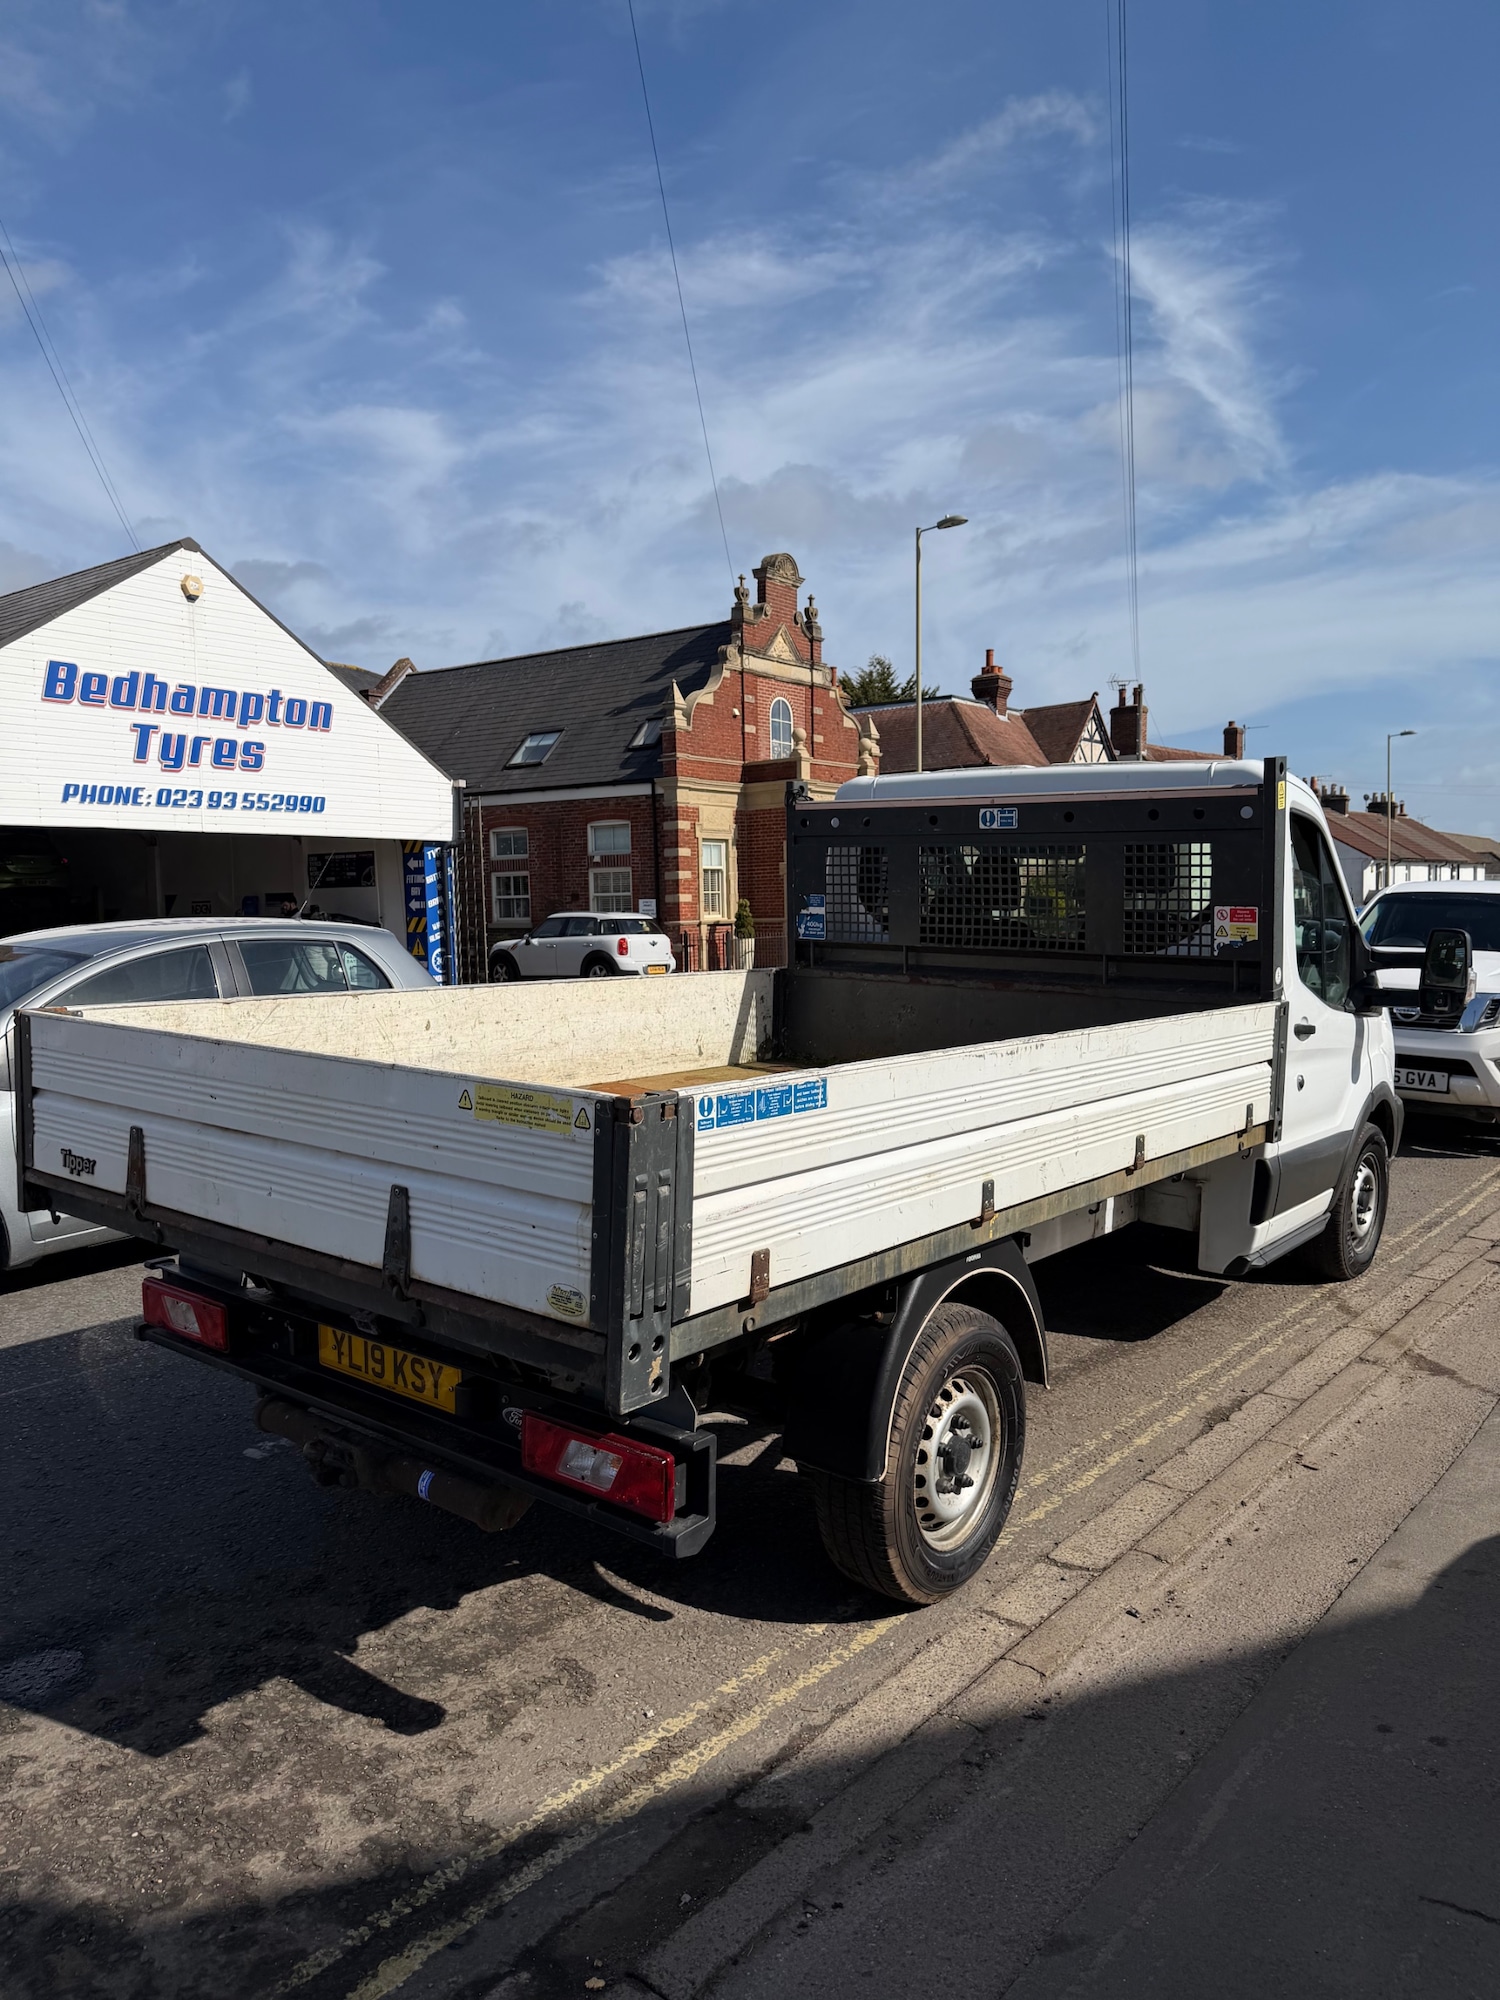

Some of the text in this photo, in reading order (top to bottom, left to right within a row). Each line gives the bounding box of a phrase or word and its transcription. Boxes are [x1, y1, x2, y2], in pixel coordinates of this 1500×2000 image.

[42, 660, 333, 731] Bedhampton
[130, 723, 266, 772] Tyres
[60, 783, 327, 814] PHONE: 023 93 552990
[1406, 1071, 1436, 1087] GVA
[510, 1092, 534, 1101] HAZARD
[60, 1148, 97, 1177] Tipper
[332, 1329, 443, 1400] YL19 KSY
